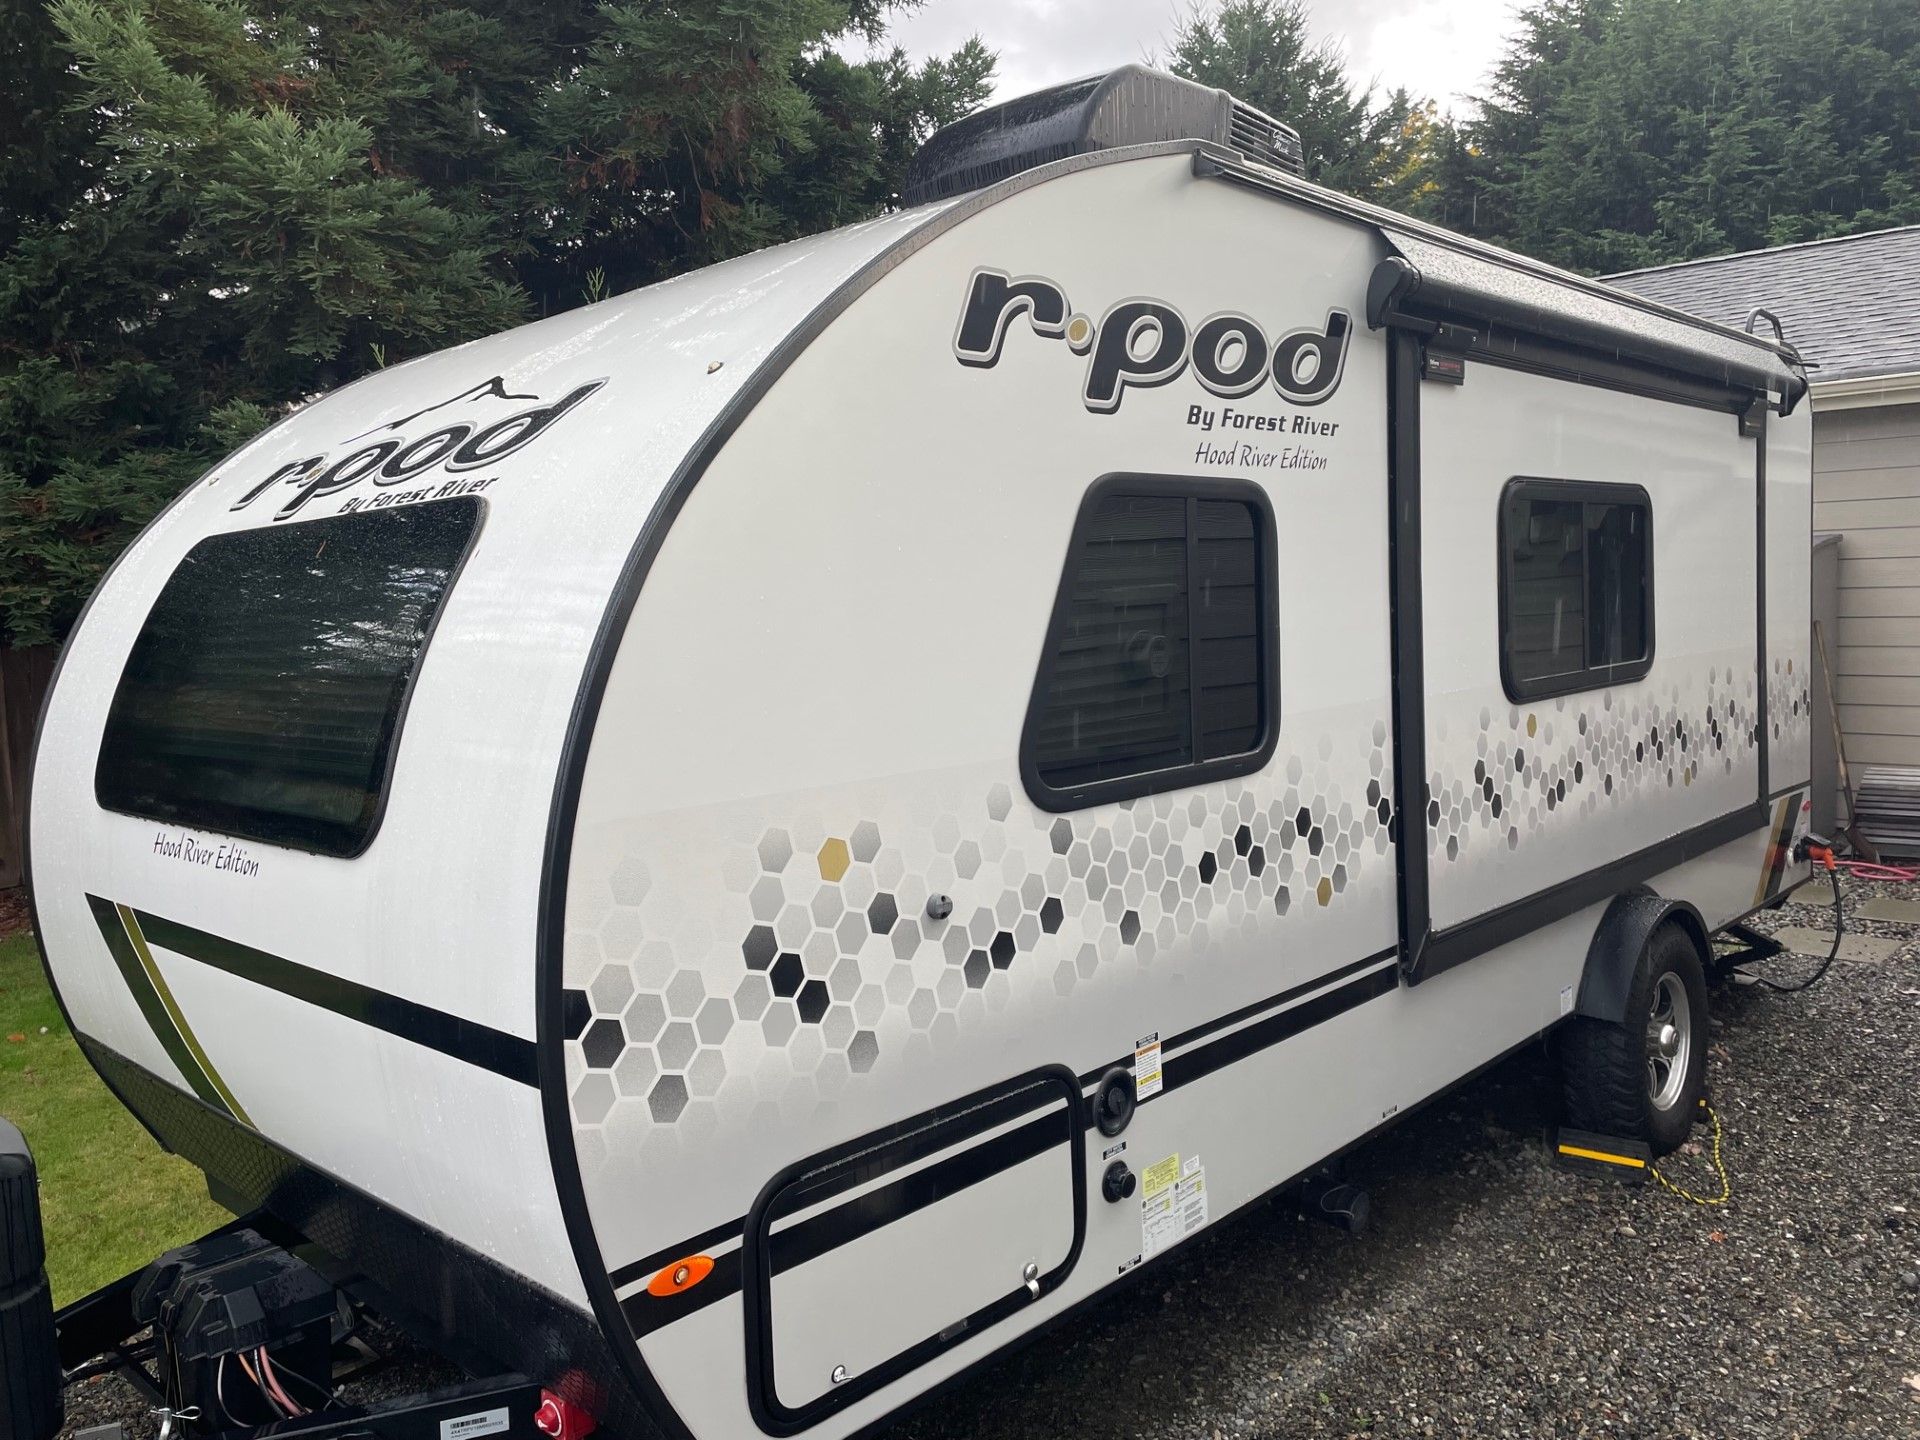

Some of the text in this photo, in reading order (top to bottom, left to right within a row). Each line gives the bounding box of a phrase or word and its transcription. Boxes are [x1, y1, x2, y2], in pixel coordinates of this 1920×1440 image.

[1187, 405, 1339, 436] By Forest River
[1195, 440, 1328, 470] Hood River Edition
[337, 477, 500, 514] By Forest River
[153, 832, 259, 877] Hood River Edition
